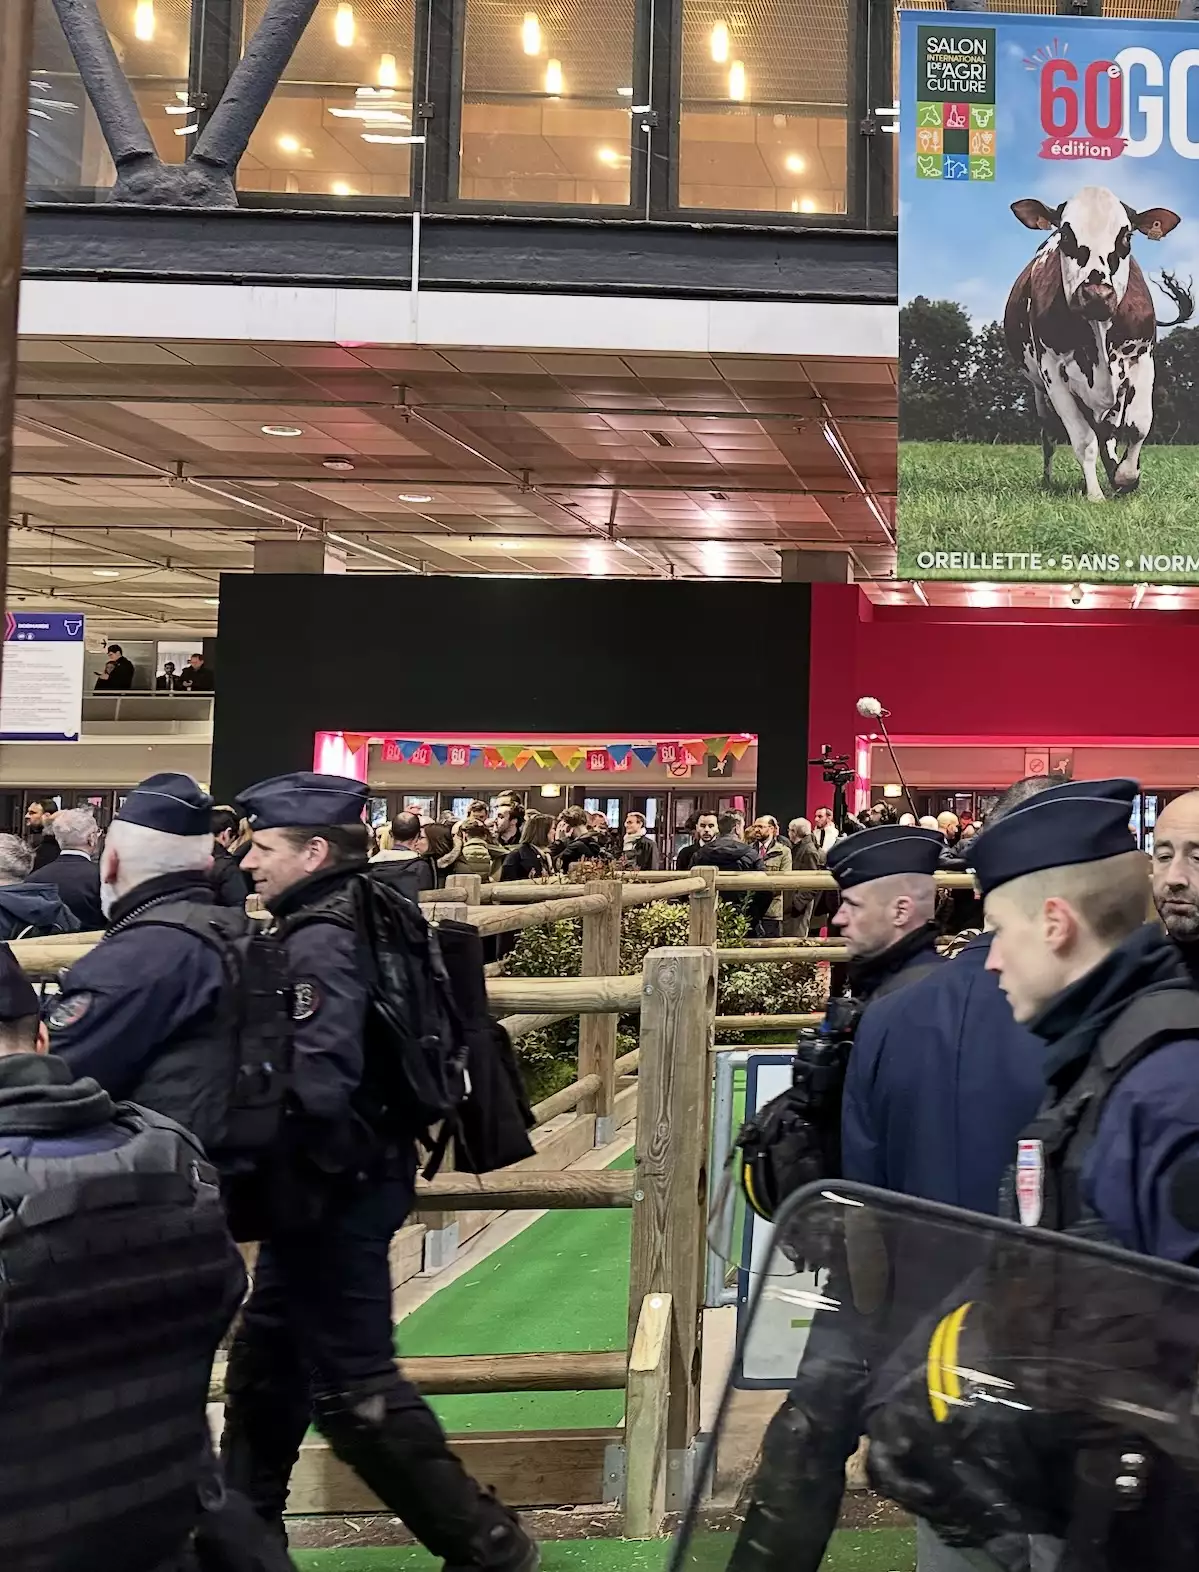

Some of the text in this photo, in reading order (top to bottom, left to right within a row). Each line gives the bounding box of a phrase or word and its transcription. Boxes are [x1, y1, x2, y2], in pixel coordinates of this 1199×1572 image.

[927, 36, 986, 55] SALON
[927, 54, 986, 63] INTERNATIONAL
[927, 79, 986, 93] CULTURE
[1051, 140, 1111, 156] édition
[917, 551, 1042, 569] OREILLETTE
[452, 749, 465, 760] 60
[662, 746, 674, 757] 60
[591, 754, 604, 765] 60
